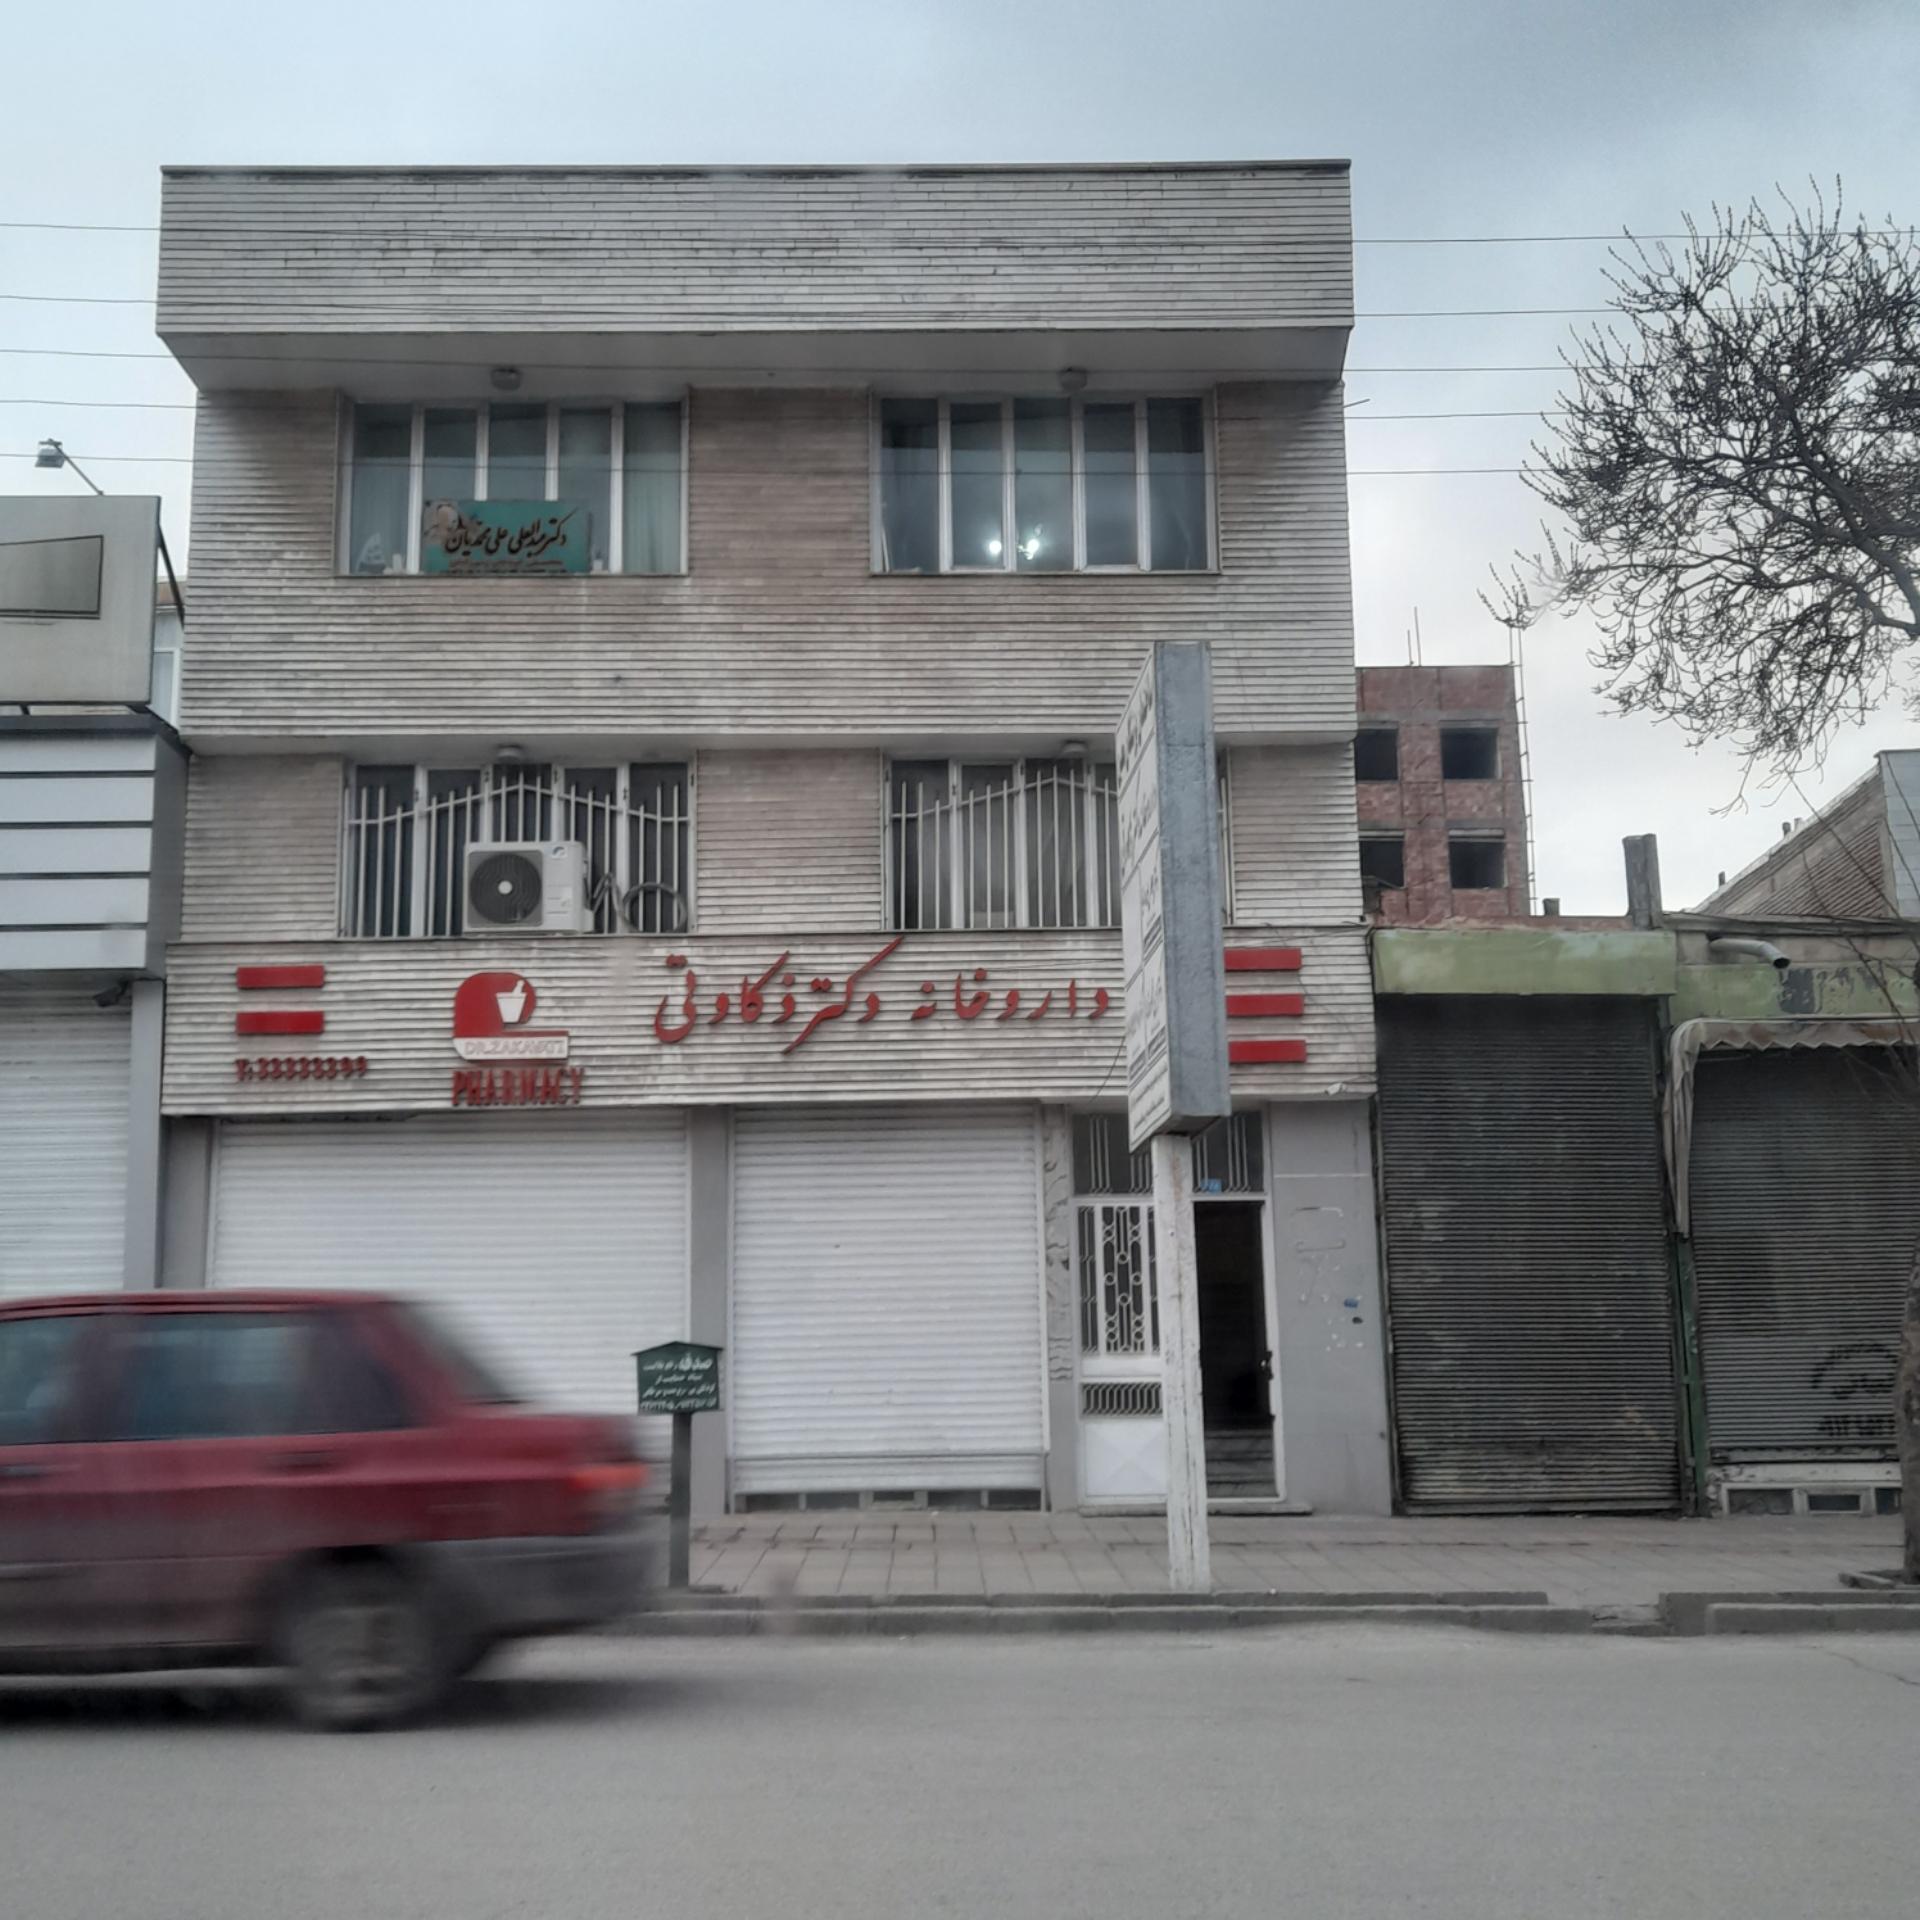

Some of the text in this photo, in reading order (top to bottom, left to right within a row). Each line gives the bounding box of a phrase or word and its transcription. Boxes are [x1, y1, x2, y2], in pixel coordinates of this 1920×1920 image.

[654, 950, 796, 1044] ذکاوتی
[782, 936, 904, 1056] دکتر
[910, 967, 1109, 1021] داروخانه
[451, 1067, 585, 1107] PHARMACY
